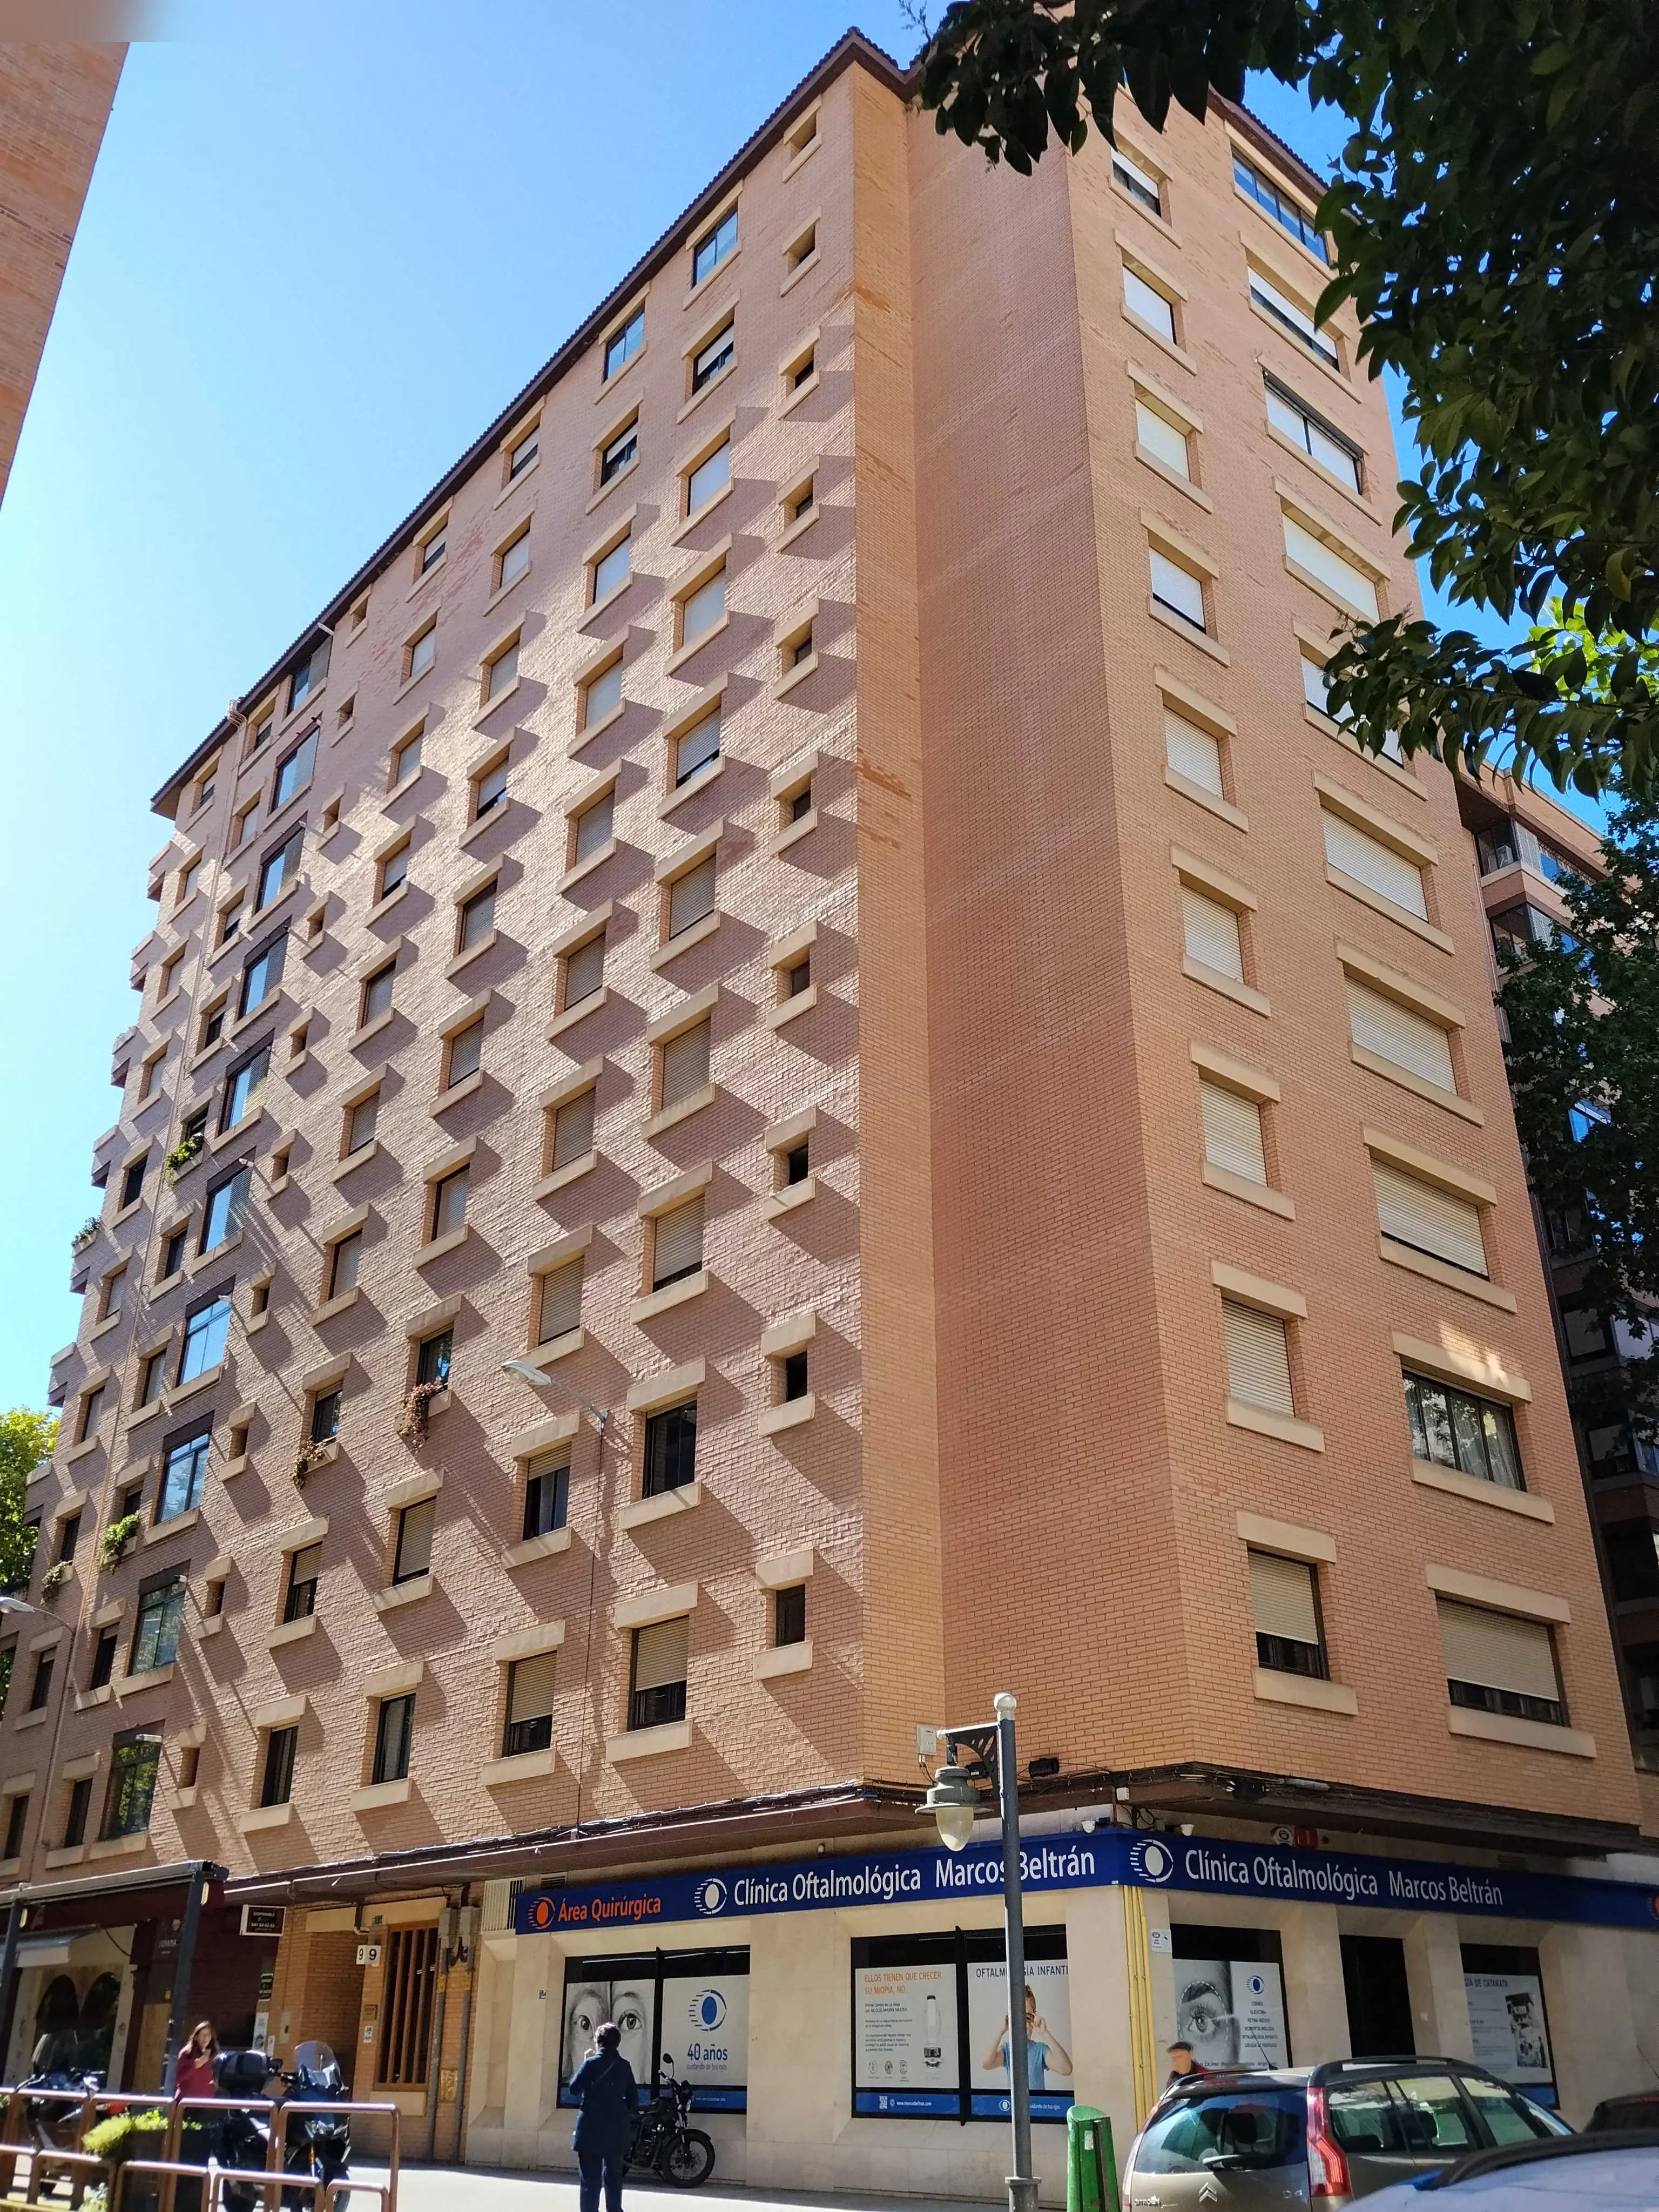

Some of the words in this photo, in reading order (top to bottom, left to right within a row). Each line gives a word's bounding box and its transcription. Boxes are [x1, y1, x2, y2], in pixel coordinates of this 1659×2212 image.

[734, 1877, 787, 1905] Clínica
[793, 1864, 920, 1900] Oftalmológica
[1020, 1845, 1095, 1880] Beltrán
[1185, 1850, 1249, 1884] Clínica
[1254, 1857, 1378, 1900] Oftalmológica
[1389, 1871, 1446, 1900] Marcos
[1448, 1877, 1503, 1905] Beltrán
[557, 1898, 588, 1922] Área
[592, 1893, 661, 1921] Quirúrgica
[359, 1948, 363, 1960] 9
[369, 1948, 377, 1960] 9
[864, 1974, 881, 1982] ELLOS
[884, 1973, 903, 1981] TIENEN
[905, 1972, 917, 1980] QUE
[687, 2043, 701, 2060] 40
[703, 2044, 727, 2060] años
